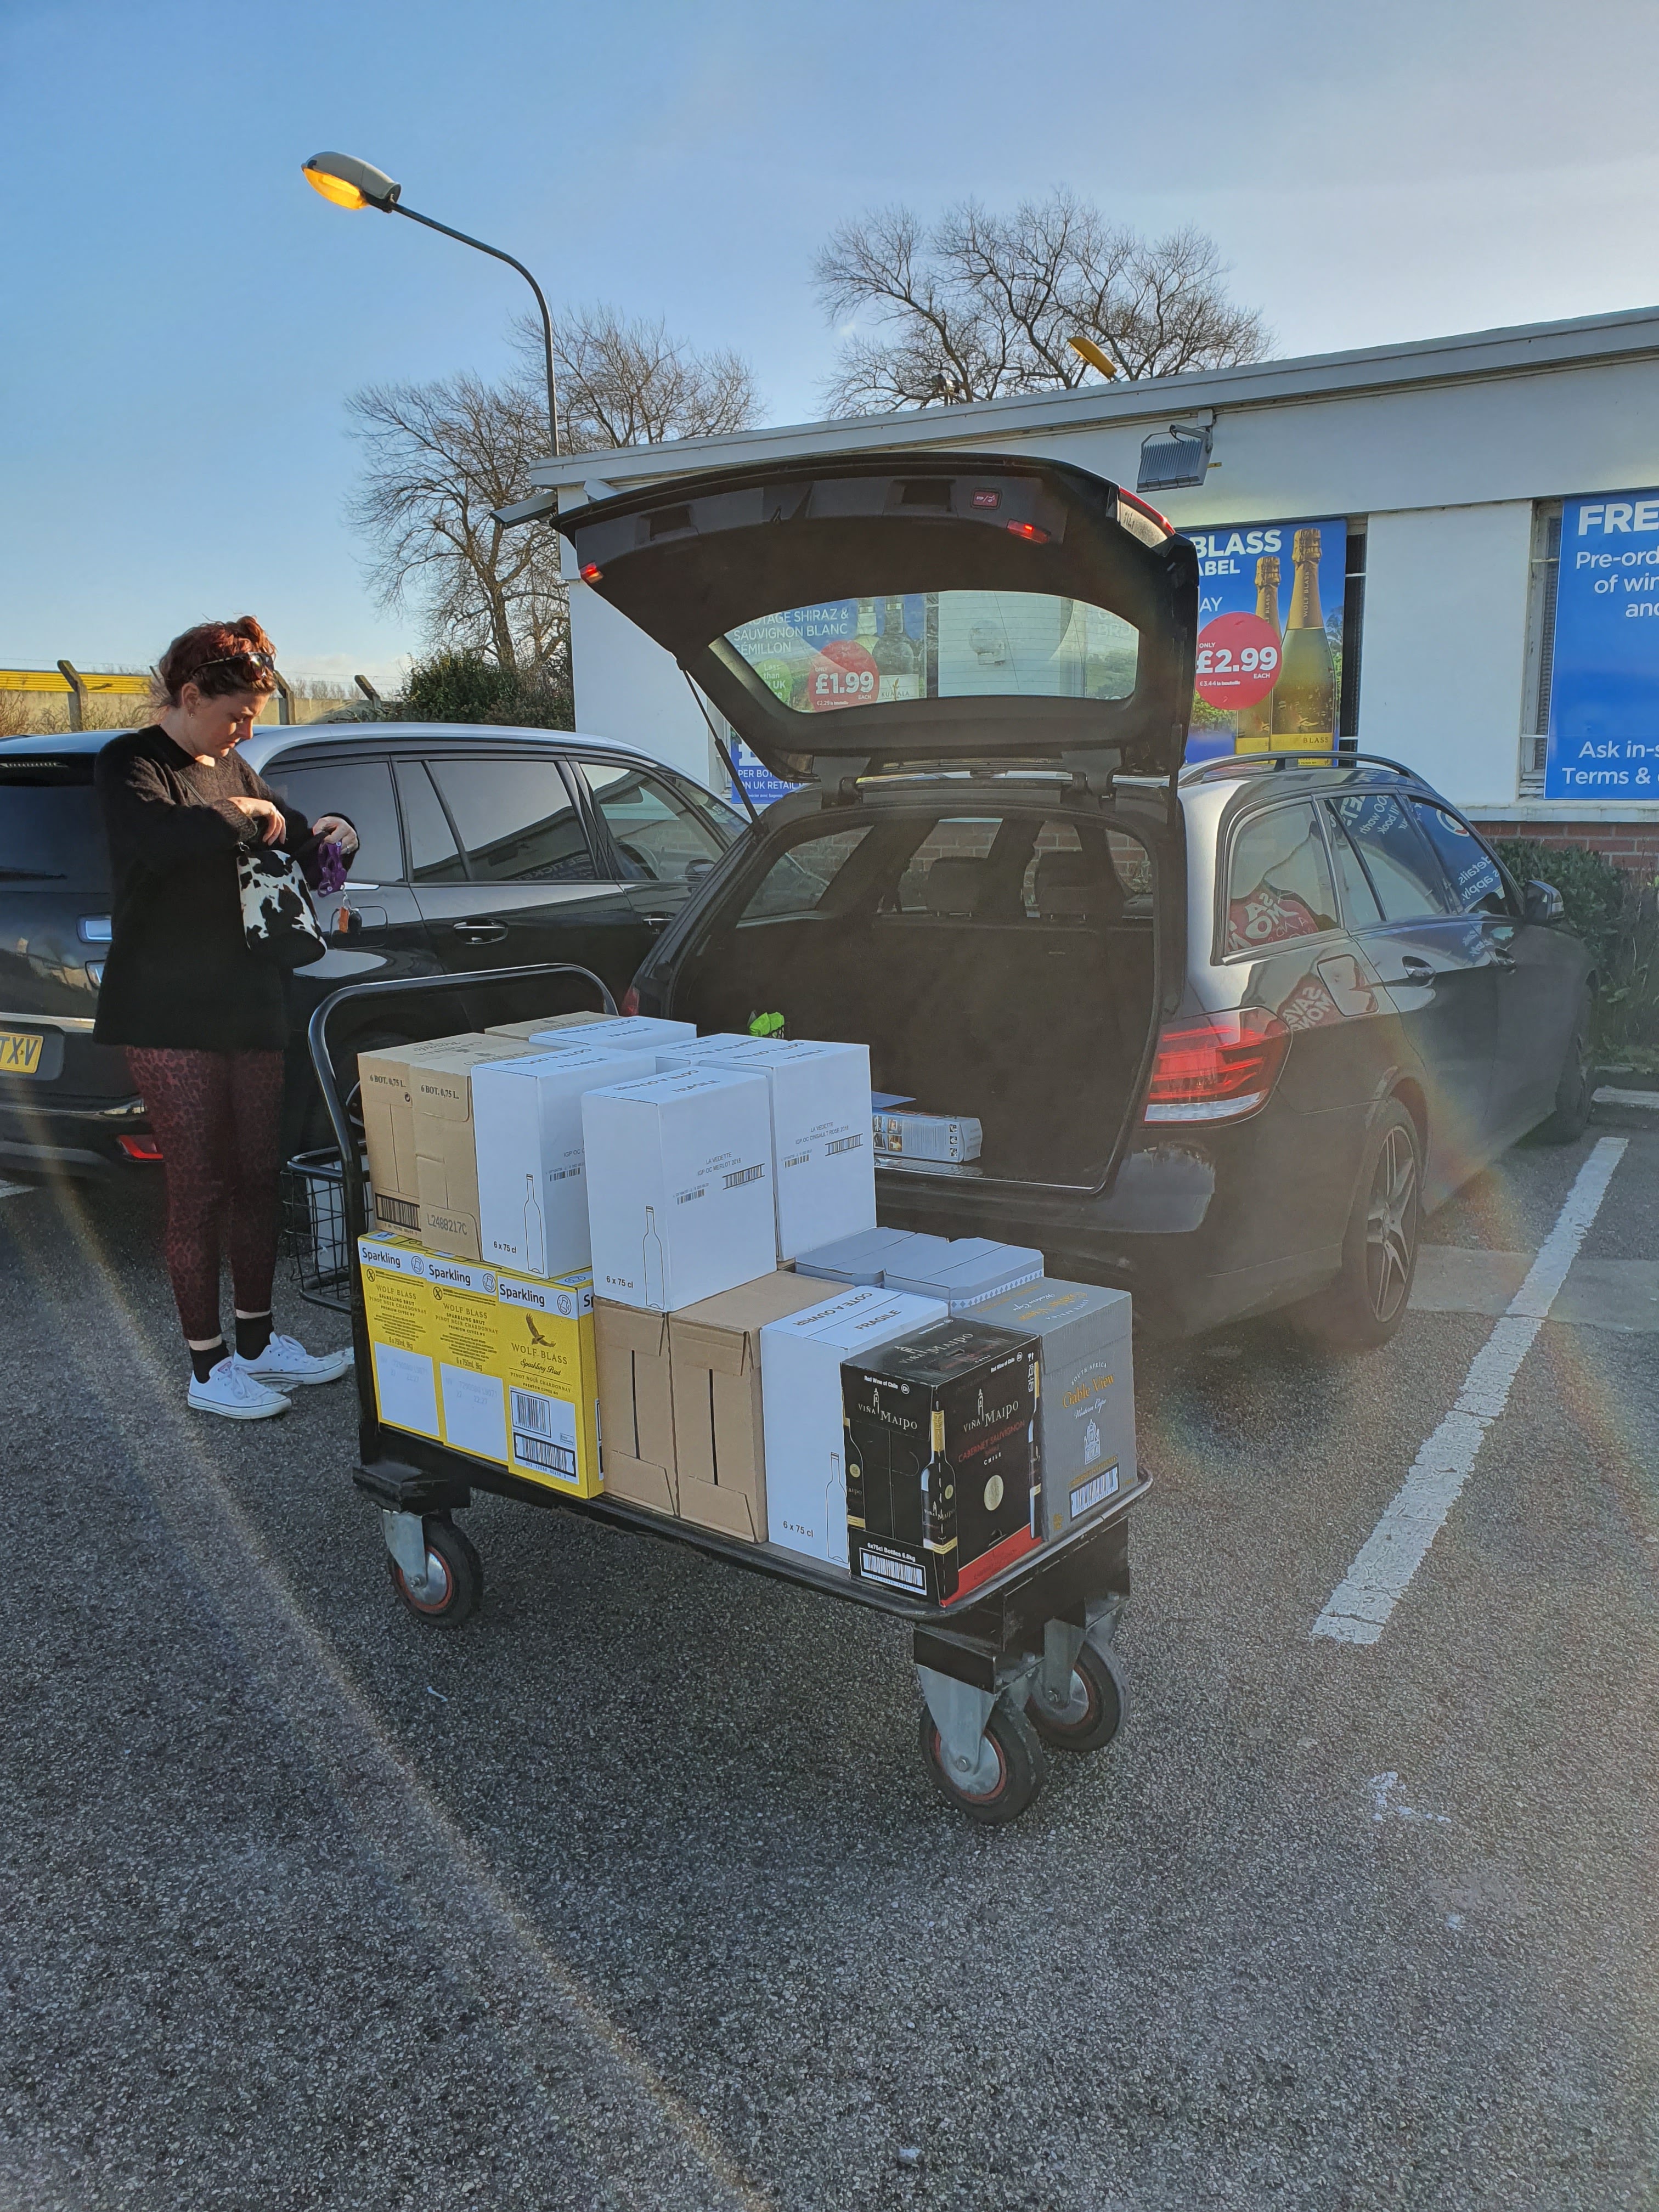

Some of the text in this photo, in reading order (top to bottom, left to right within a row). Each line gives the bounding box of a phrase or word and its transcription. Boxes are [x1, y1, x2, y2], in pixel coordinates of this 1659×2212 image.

[1578, 501, 1659, 537] FRE
[1191, 529, 1282, 558] BLASS
[1576, 545, 1659, 569] Pre-ord
[1594, 574, 1619, 594] of
[794, 606, 849, 623] SHIRAZ &
[733, 623, 848, 641] SAUVIGNON BLANC
[764, 663, 780, 672] Less
[1196, 646, 1278, 674] £2.99
[773, 680, 786, 690] UK
[816, 671, 874, 695] £1.99
[1578, 741, 1621, 759] Ask
[738, 769, 754, 778] PER
[1562, 766, 1651, 785] Terms &
[753, 781, 797, 789] UK RETAIL
[0, 1035, 38, 1066] TXV
[560, 1048, 592, 1058] COTE
[557, 1057, 608, 1068] FRAGILE
[375, 1075, 388, 1085] BOT.
[400, 1080, 406, 1088] L.
[667, 1070, 699, 1080] COTE
[421, 1084, 460, 1099] 6 BOT. 0,75 L.
[671, 1079, 720, 1092] FRAGILE
[816, 1121, 834, 1131] VEDETTE
[712, 1152, 732, 1163] VEDETTE
[706, 1166, 713, 1174] OC
[713, 1161, 731, 1171] MERLOT
[503, 1243, 511, 1252] 75
[512, 1245, 517, 1254] cl
[362, 1247, 401, 1268] Sparkling
[428, 1264, 471, 1286] Sparkling
[606, 1274, 611, 1284] 6
[617, 1277, 627, 1287] 75
[627, 1279, 634, 1289] cl
[376, 1284, 417, 1300] WOLF BLASS
[499, 1284, 545, 1307] Sparkling
[842, 1292, 873, 1307] COTE
[443, 1302, 488, 1319] WOLF BLASS
[446, 1312, 486, 1326] SPARKLING BRUT
[792, 1309, 836, 1326] OUVRIR
[465, 1322, 499, 1335] CHARDONNAY
[854, 1310, 902, 1330] FRAGILE
[511, 1342, 537, 1356] WOLF
[541, 1350, 568, 1365] BLASS
[520, 1358, 561, 1376] Sparkling Brut
[1071, 1362, 1107, 1386] SOUTH AFRICA
[510, 1372, 525, 1380] PINOT
[539, 1380, 571, 1393] CHARDONNAY
[858, 1403, 876, 1415] VIÑA
[963, 1419, 981, 1433] VIÑA
[958, 1439, 990, 1463] CABERNET
[990, 1419, 1025, 1444] SAUVIGNON
[783, 1520, 788, 1529] 6
[795, 1523, 805, 1534] 75
[806, 1527, 814, 1538] cl
[884, 1547, 902, 1558] Bottles
